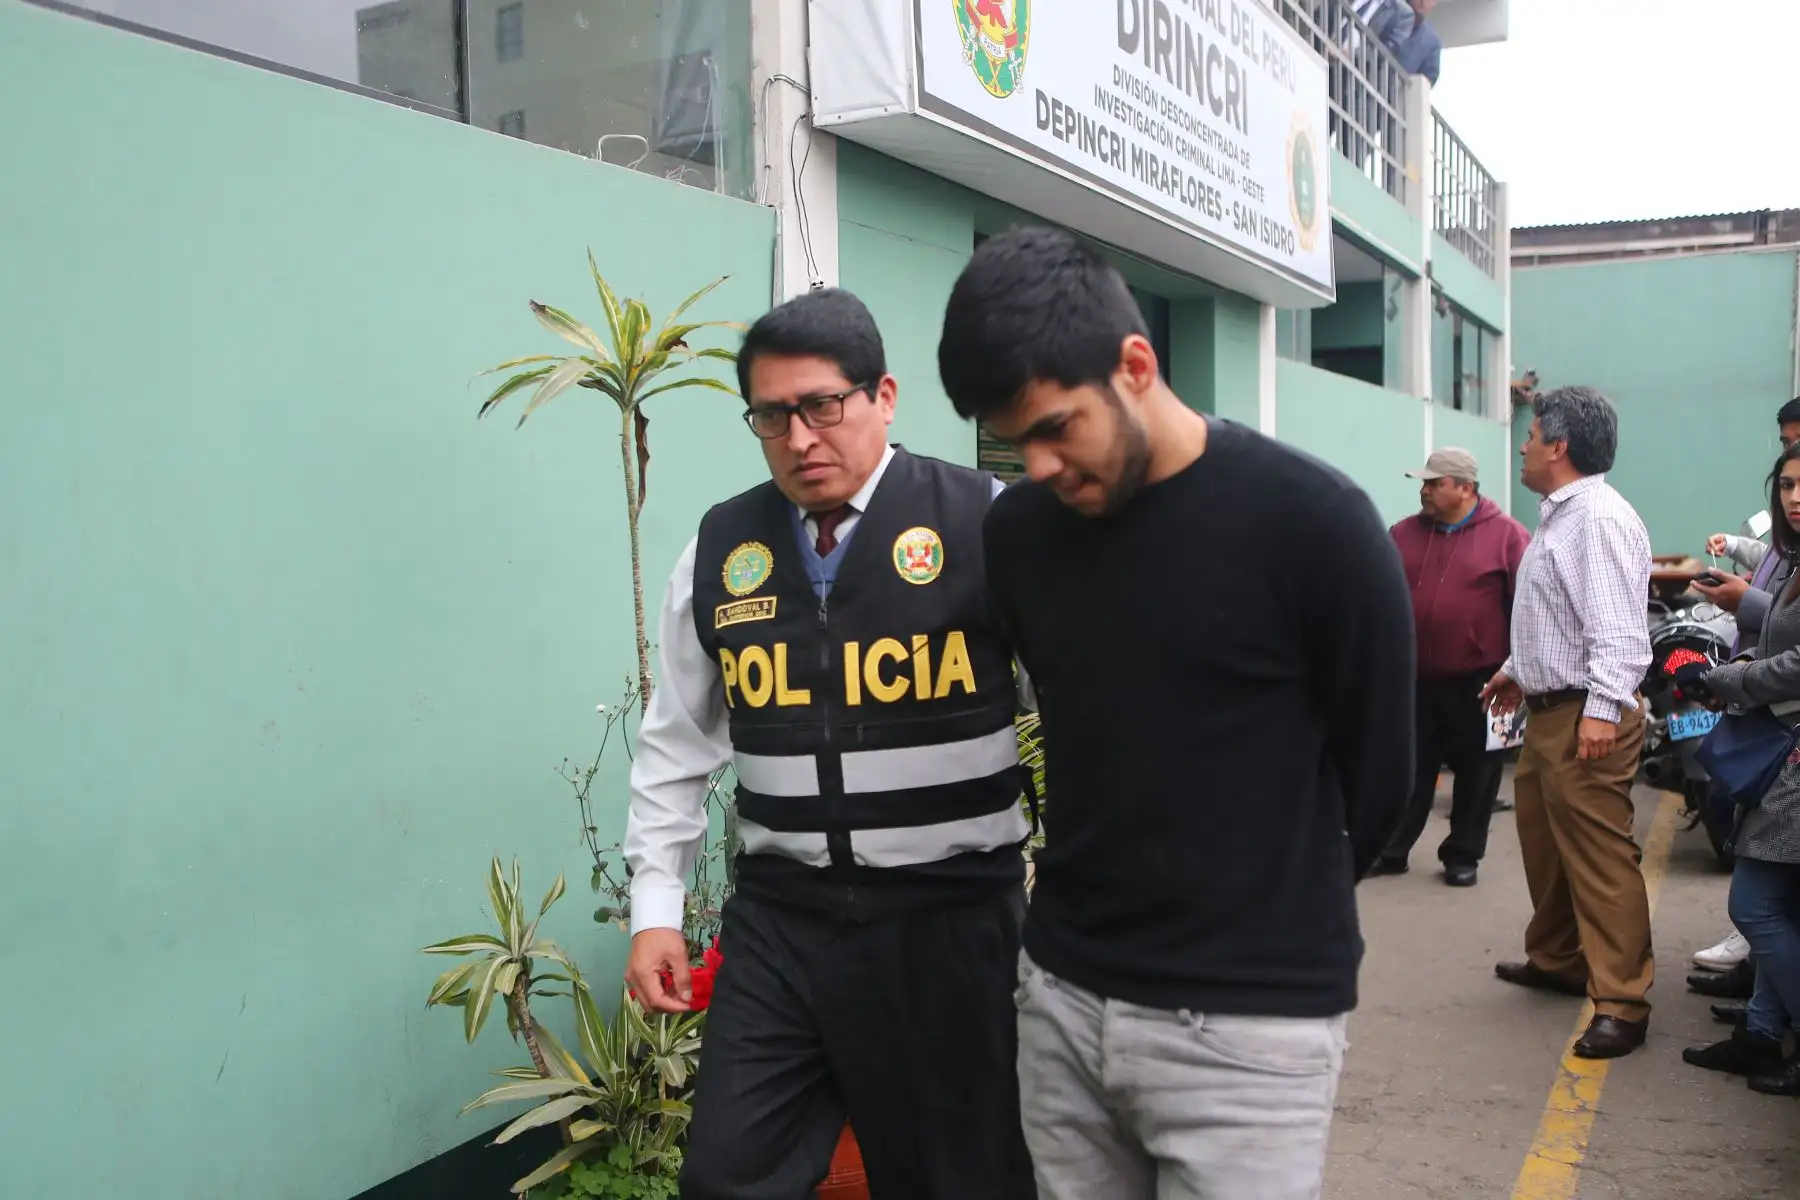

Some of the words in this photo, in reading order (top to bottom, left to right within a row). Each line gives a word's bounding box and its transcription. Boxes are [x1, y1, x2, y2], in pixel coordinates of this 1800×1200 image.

[1117, 0, 1248, 136] DIRINCRI
[1231, 0, 1259, 66] DEL
[1035, 87, 1126, 173] DEPINCRI
[1131, 142, 1222, 222] MIRAFLORES
[1233, 200, 1257, 239] SAN
[1260, 214, 1295, 257] ISIDRO
[1094, 83, 1173, 151] INVESTIGACIÓN
[1175, 135, 1216, 176] CRIMINAL
[1217, 159, 1236, 188] LIMA
[1242, 175, 1265, 204] OESTE
[1113, 63, 1158, 113] DIVISIÓN
[1160, 95, 1239, 165] DESCONCENTRADA
[1240, 148, 1250, 170] DE
